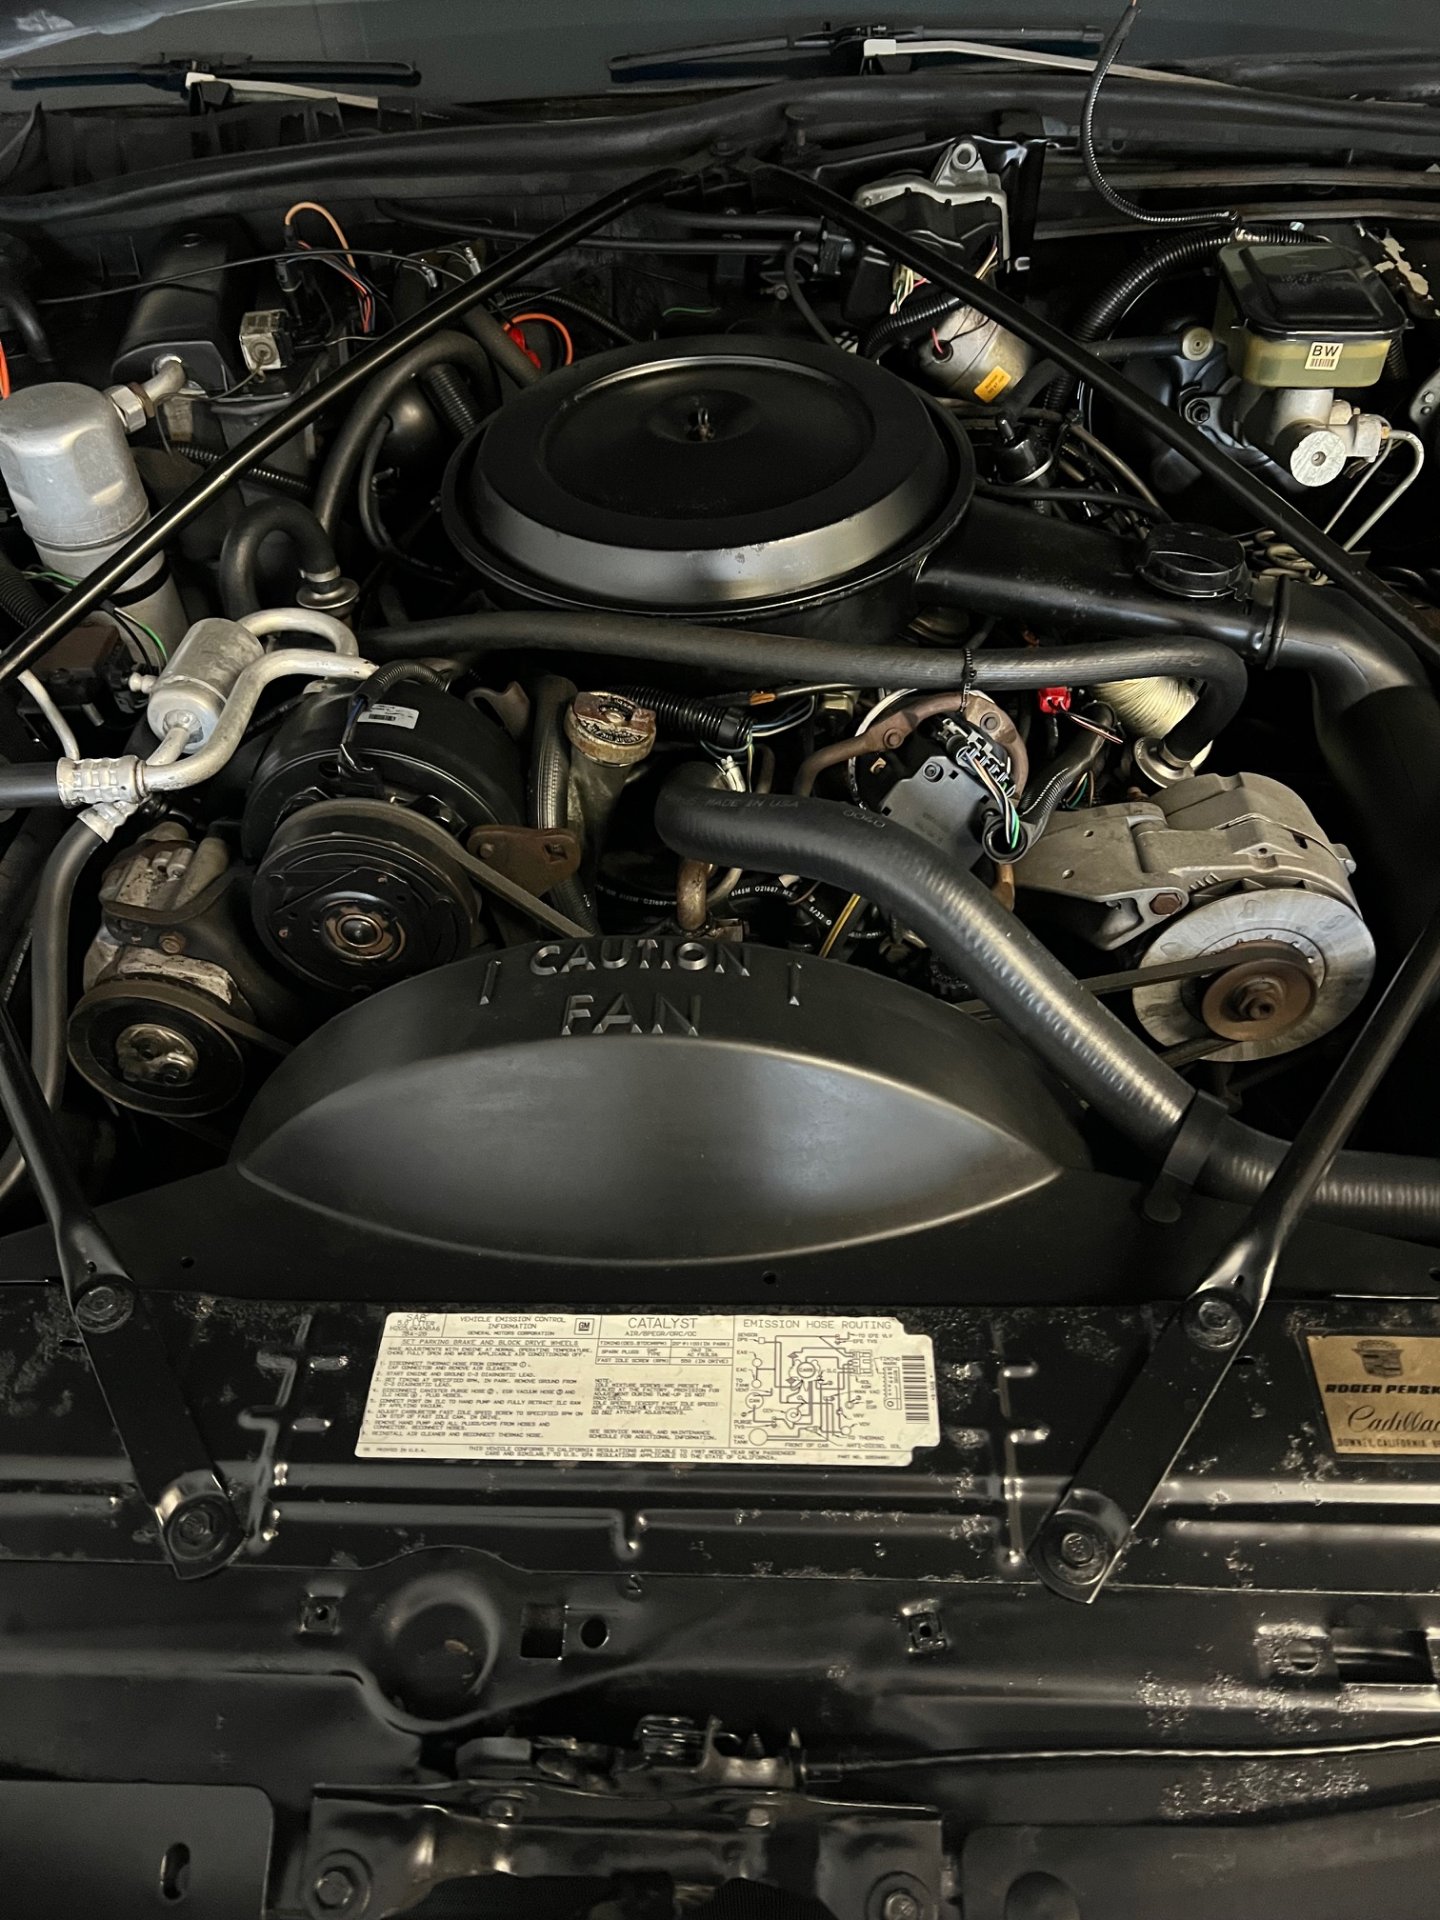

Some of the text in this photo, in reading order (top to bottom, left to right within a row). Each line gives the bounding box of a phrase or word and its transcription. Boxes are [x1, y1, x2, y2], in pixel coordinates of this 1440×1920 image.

[1311, 344, 1340, 357] BW
[530, 939, 750, 976] CAUTION
[561, 993, 701, 1036] FAN
[628, 1317, 697, 1329] CATALYST
[743, 1319, 892, 1329] EMISSION HOSE ROUTING
[1325, 1384, 1382, 1394] ROGER
